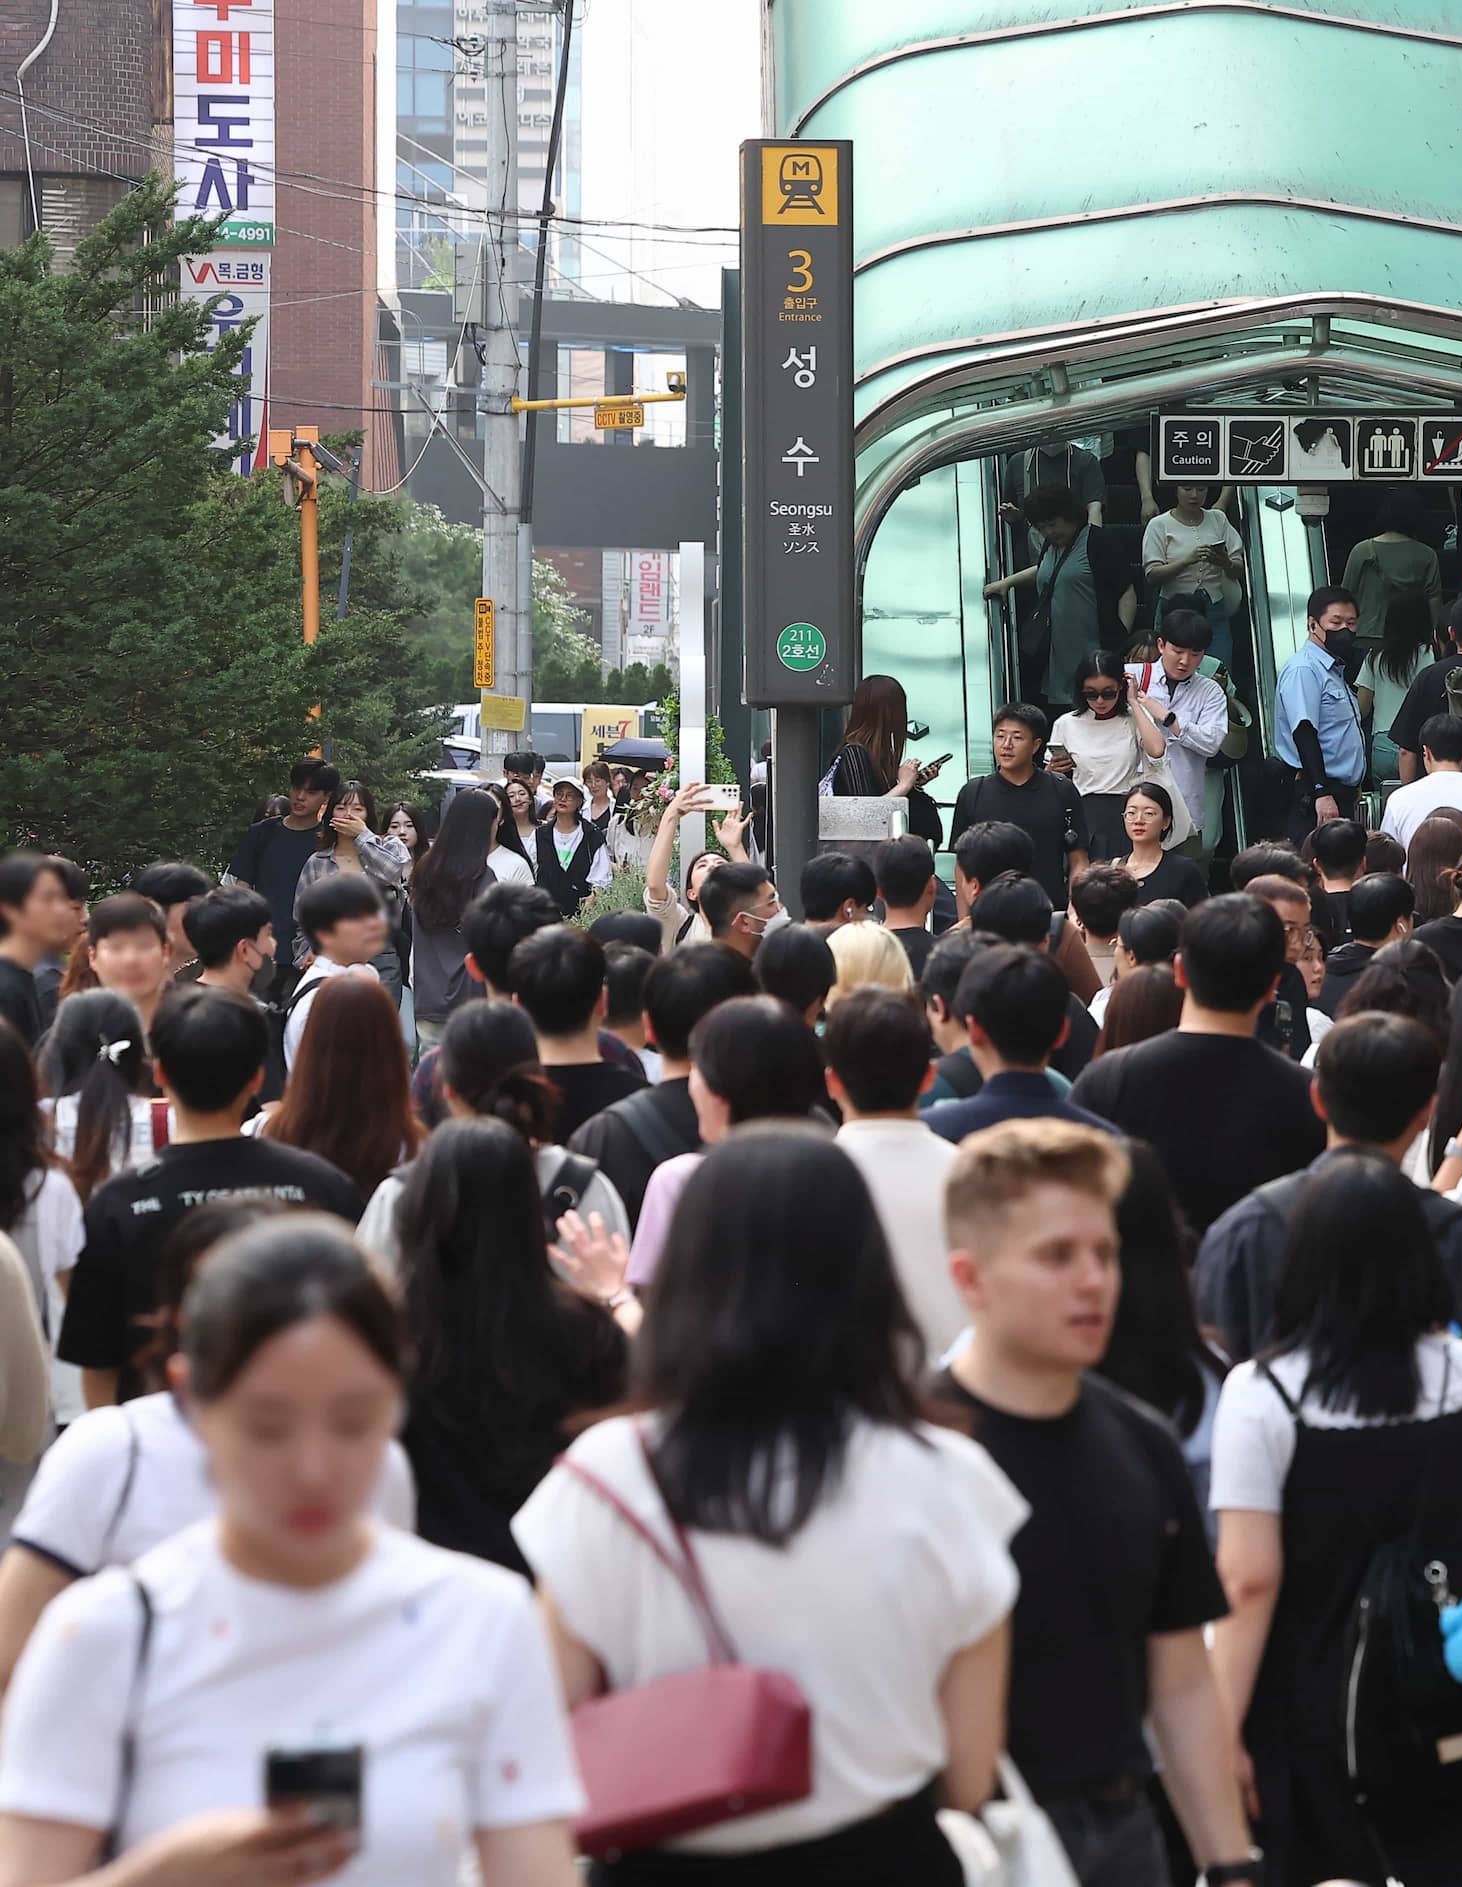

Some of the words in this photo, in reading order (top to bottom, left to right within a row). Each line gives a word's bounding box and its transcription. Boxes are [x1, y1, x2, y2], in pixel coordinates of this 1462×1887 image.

[791, 161, 810, 176] M
[218, 262, 264, 281] 목.금형
[786, 249, 814, 293] 3
[783, 296, 819, 310] 출입구
[778, 312, 823, 323] Entrance
[597, 412, 616, 426] CCTV
[618, 410, 641, 424] 촬영중
[1171, 430, 1213, 449] 주의
[1171, 454, 1212, 465] Caution
[769, 501, 833, 519] Seongsu
[788, 522, 816, 537] 圣水
[783, 541, 820, 554] ソンス
[643, 624, 656, 634] 2F
[789, 629, 812, 642] 211
[782, 644, 820, 660] 2호선
